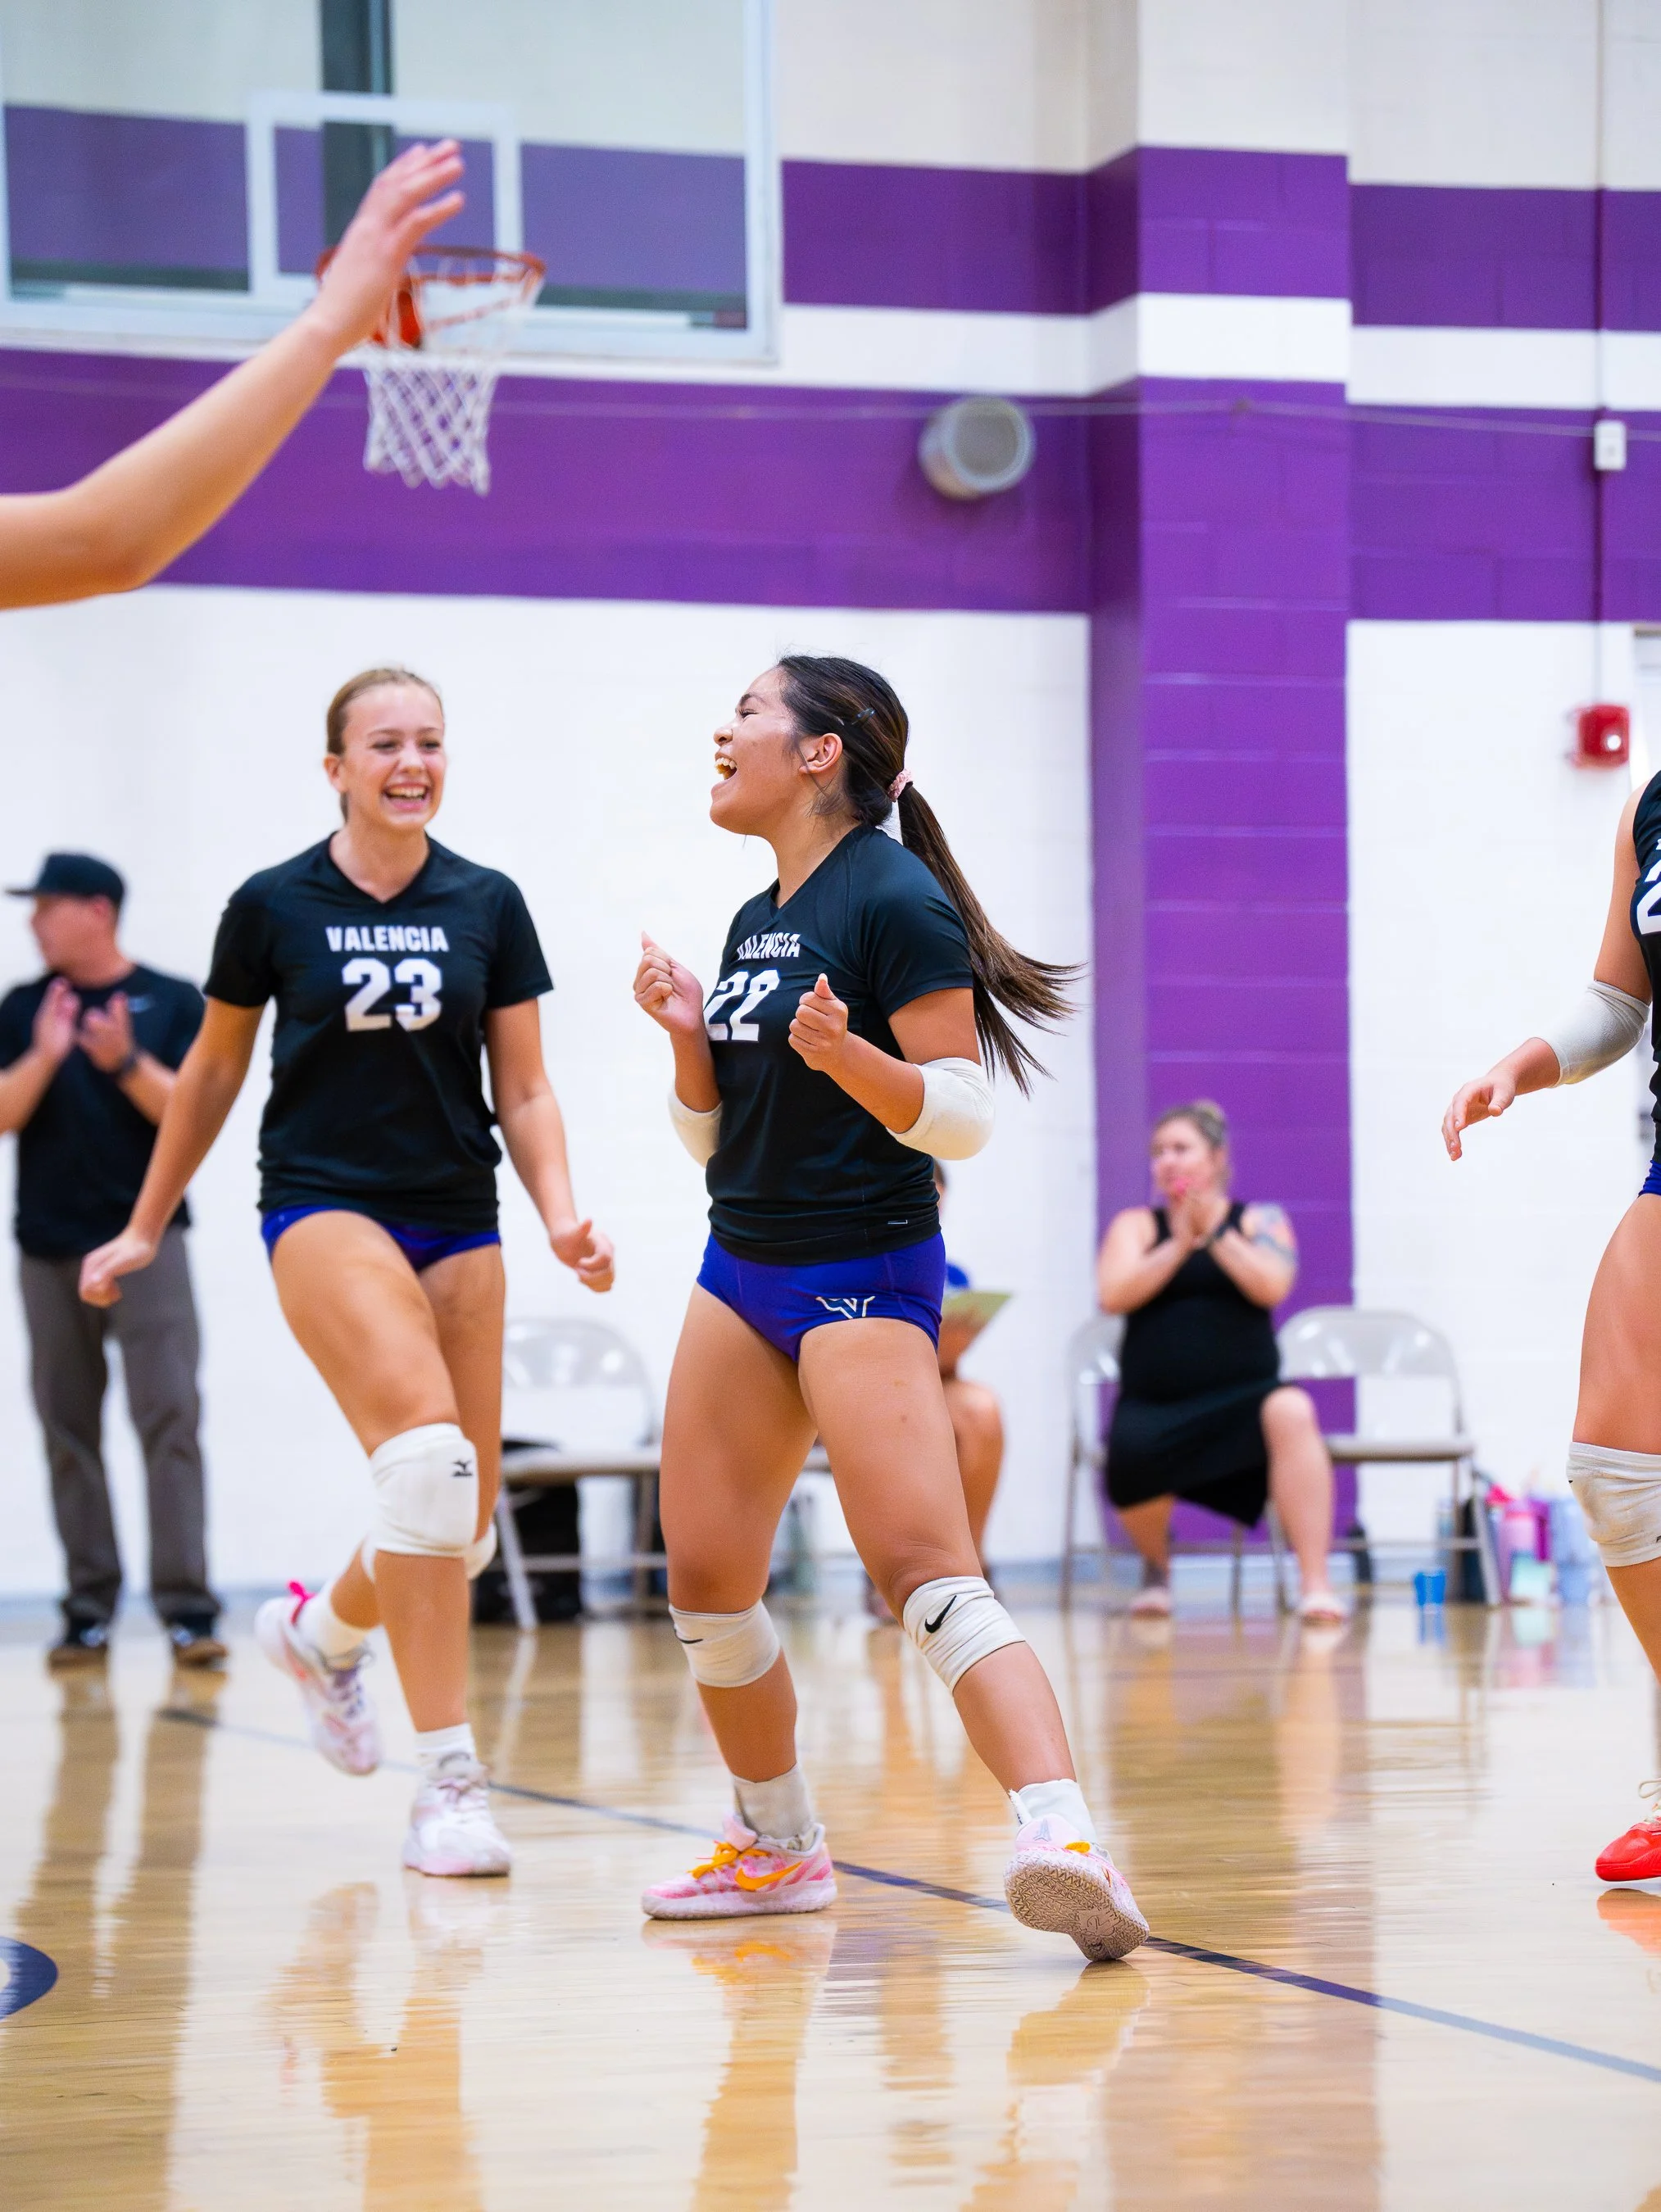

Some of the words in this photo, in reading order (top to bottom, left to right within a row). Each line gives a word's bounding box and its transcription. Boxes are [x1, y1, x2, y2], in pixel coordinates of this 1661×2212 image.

[325, 926, 450, 952] VALENCIA
[342, 957, 442, 1032] 23
[703, 969, 780, 1041] 22
